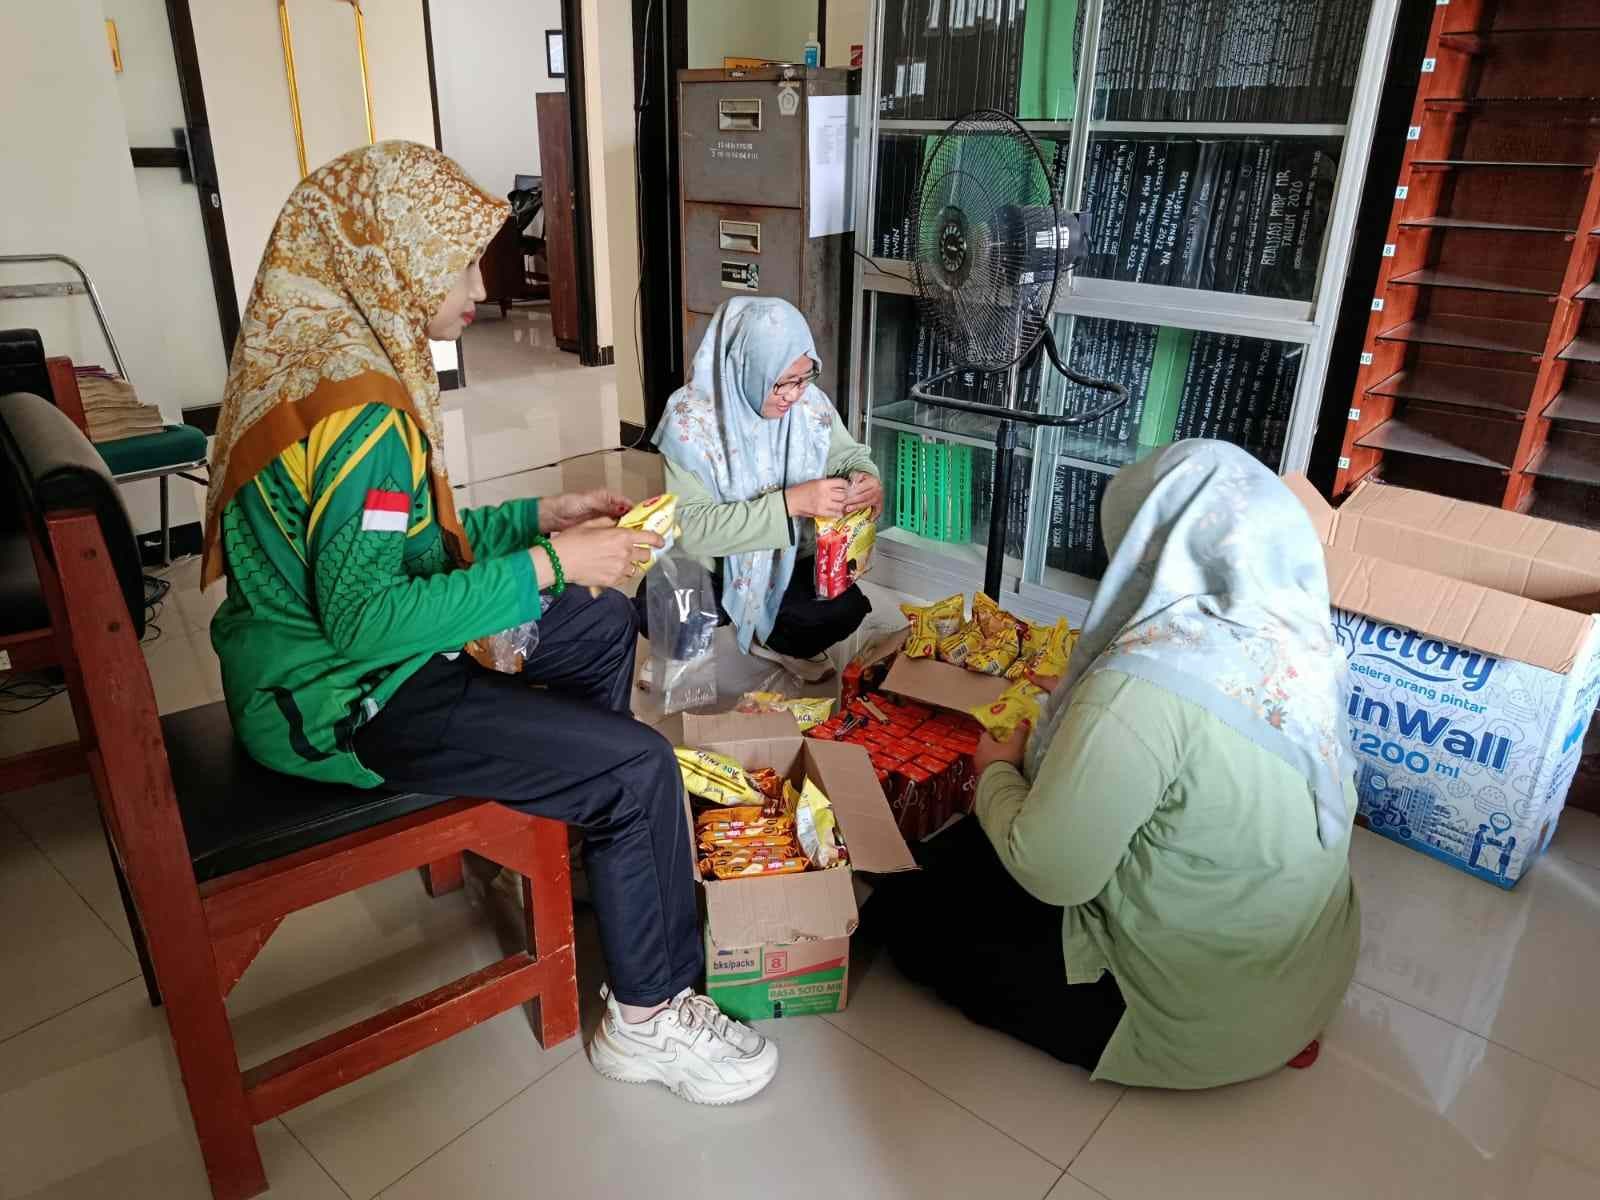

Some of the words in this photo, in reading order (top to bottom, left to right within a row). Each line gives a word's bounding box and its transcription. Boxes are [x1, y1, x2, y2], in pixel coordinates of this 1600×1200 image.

[1161, 191, 1176, 226] TAHUN
[1154, 227, 1167, 253] 2022
[1349, 662, 1391, 683] selera
[1395, 678, 1436, 700] orang
[1440, 694, 1488, 714] pintar
[1435, 762, 1460, 779] ml
[713, 959, 755, 970] bks/packs
[771, 958, 781, 969] 8
[798, 985, 824, 995] SOTO
